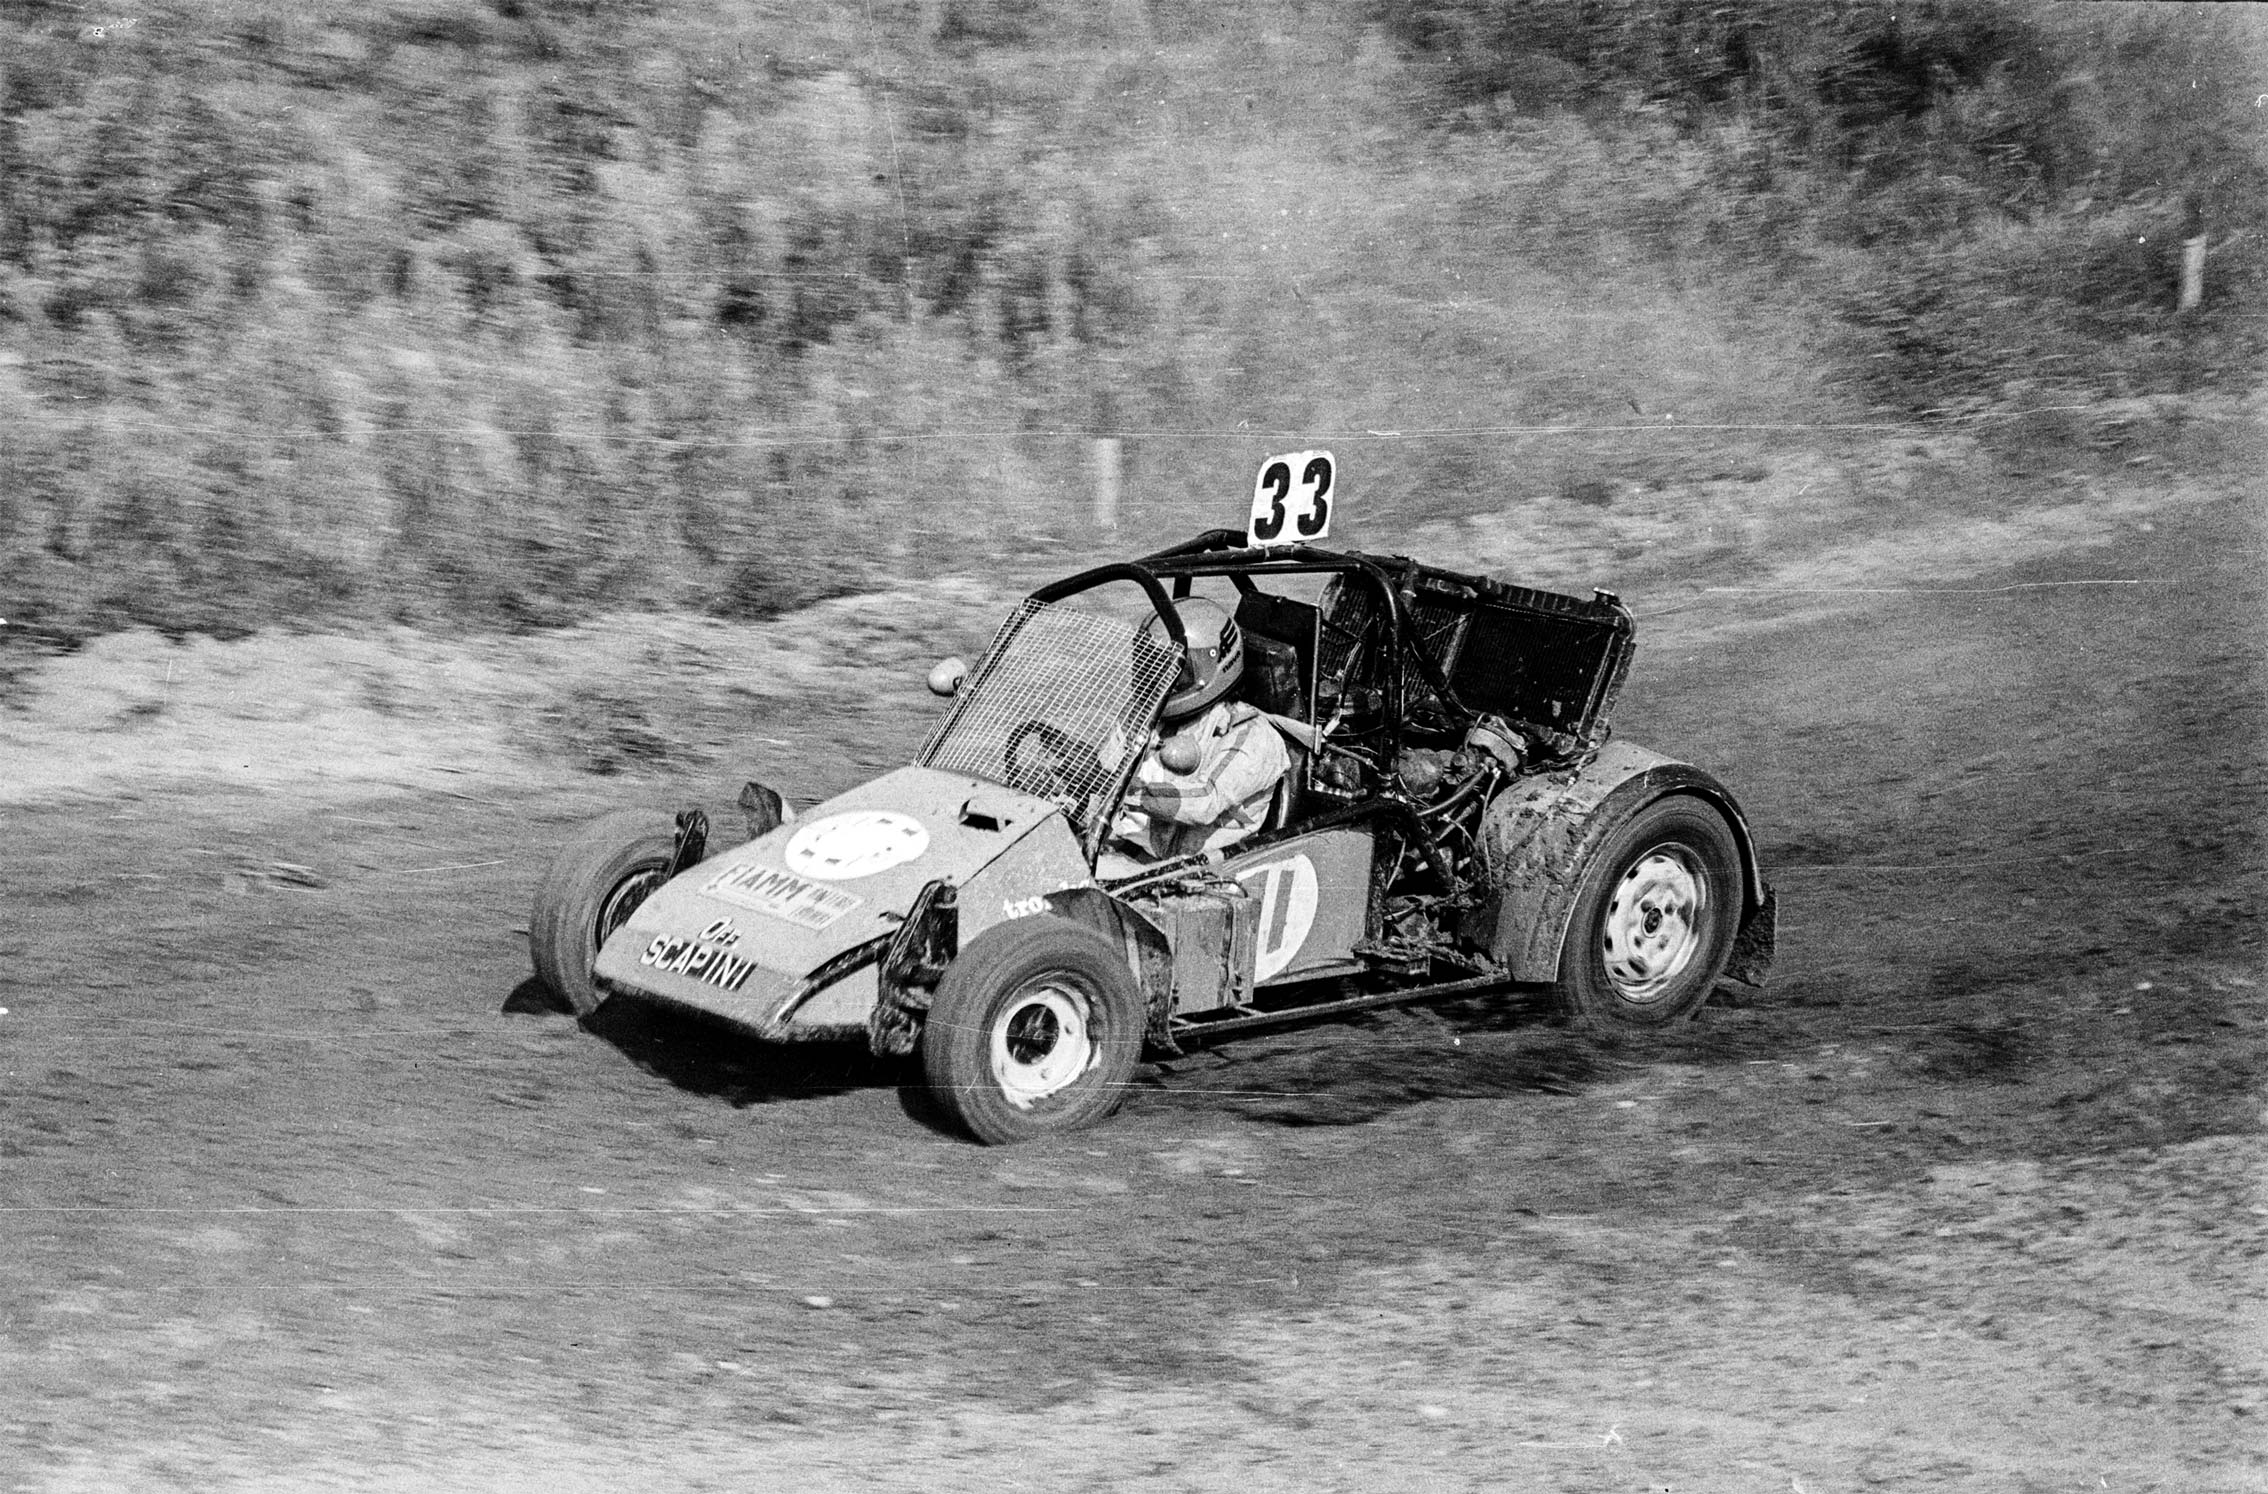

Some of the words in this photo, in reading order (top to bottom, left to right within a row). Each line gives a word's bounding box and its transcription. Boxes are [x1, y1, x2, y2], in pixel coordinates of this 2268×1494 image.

[1254, 457, 1332, 540] 33
[713, 862, 814, 902] FIAMM
[640, 933, 757, 991] SCAPINI
